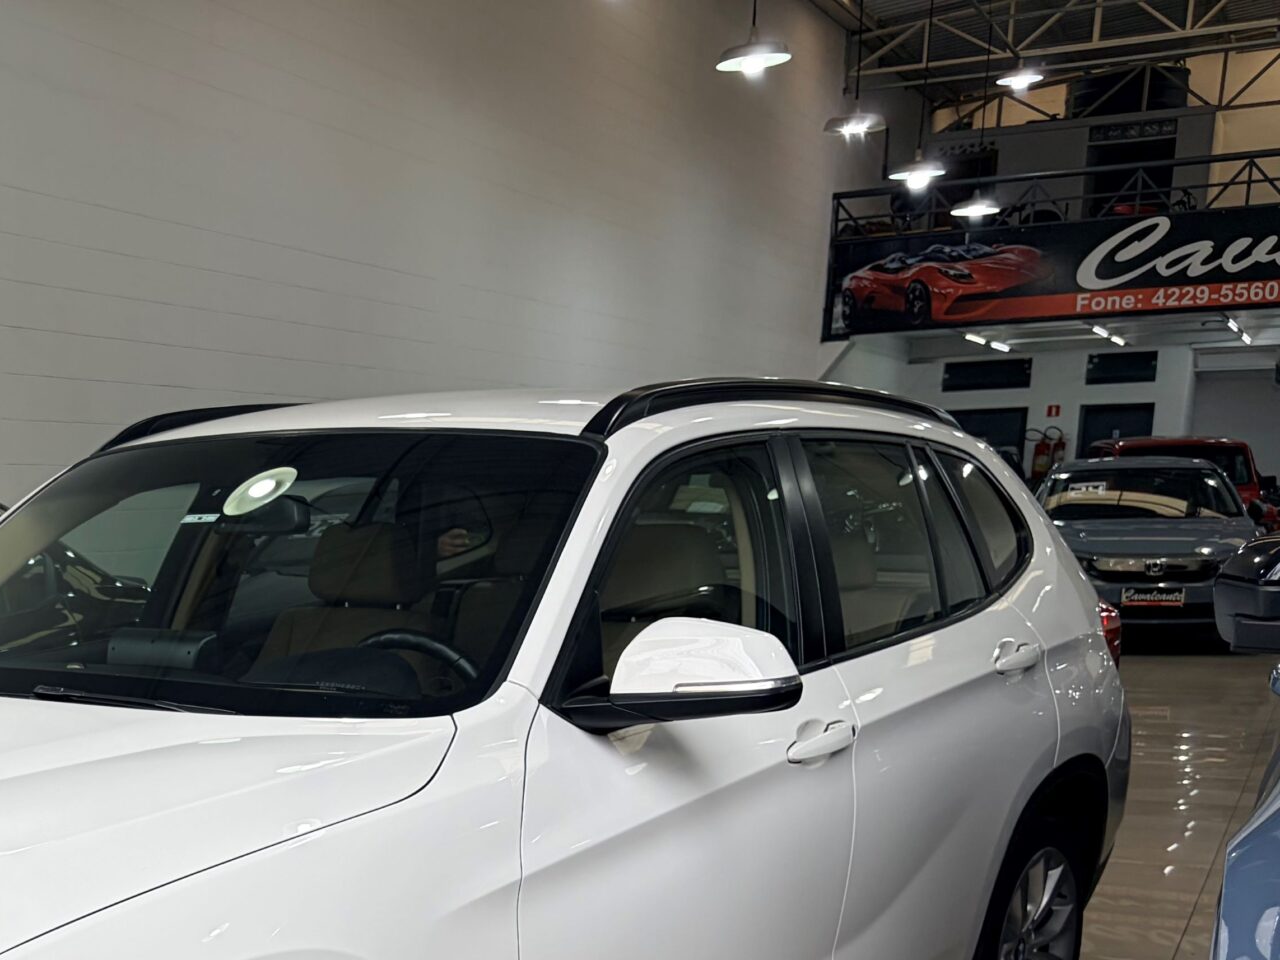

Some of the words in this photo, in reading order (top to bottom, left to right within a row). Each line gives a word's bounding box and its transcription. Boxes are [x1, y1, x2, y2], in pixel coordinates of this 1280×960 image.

[1076, 215, 1280, 290] Cav
[1075, 292, 1144, 313] Fone:
[1151, 280, 1280, 307] 4229-5560
